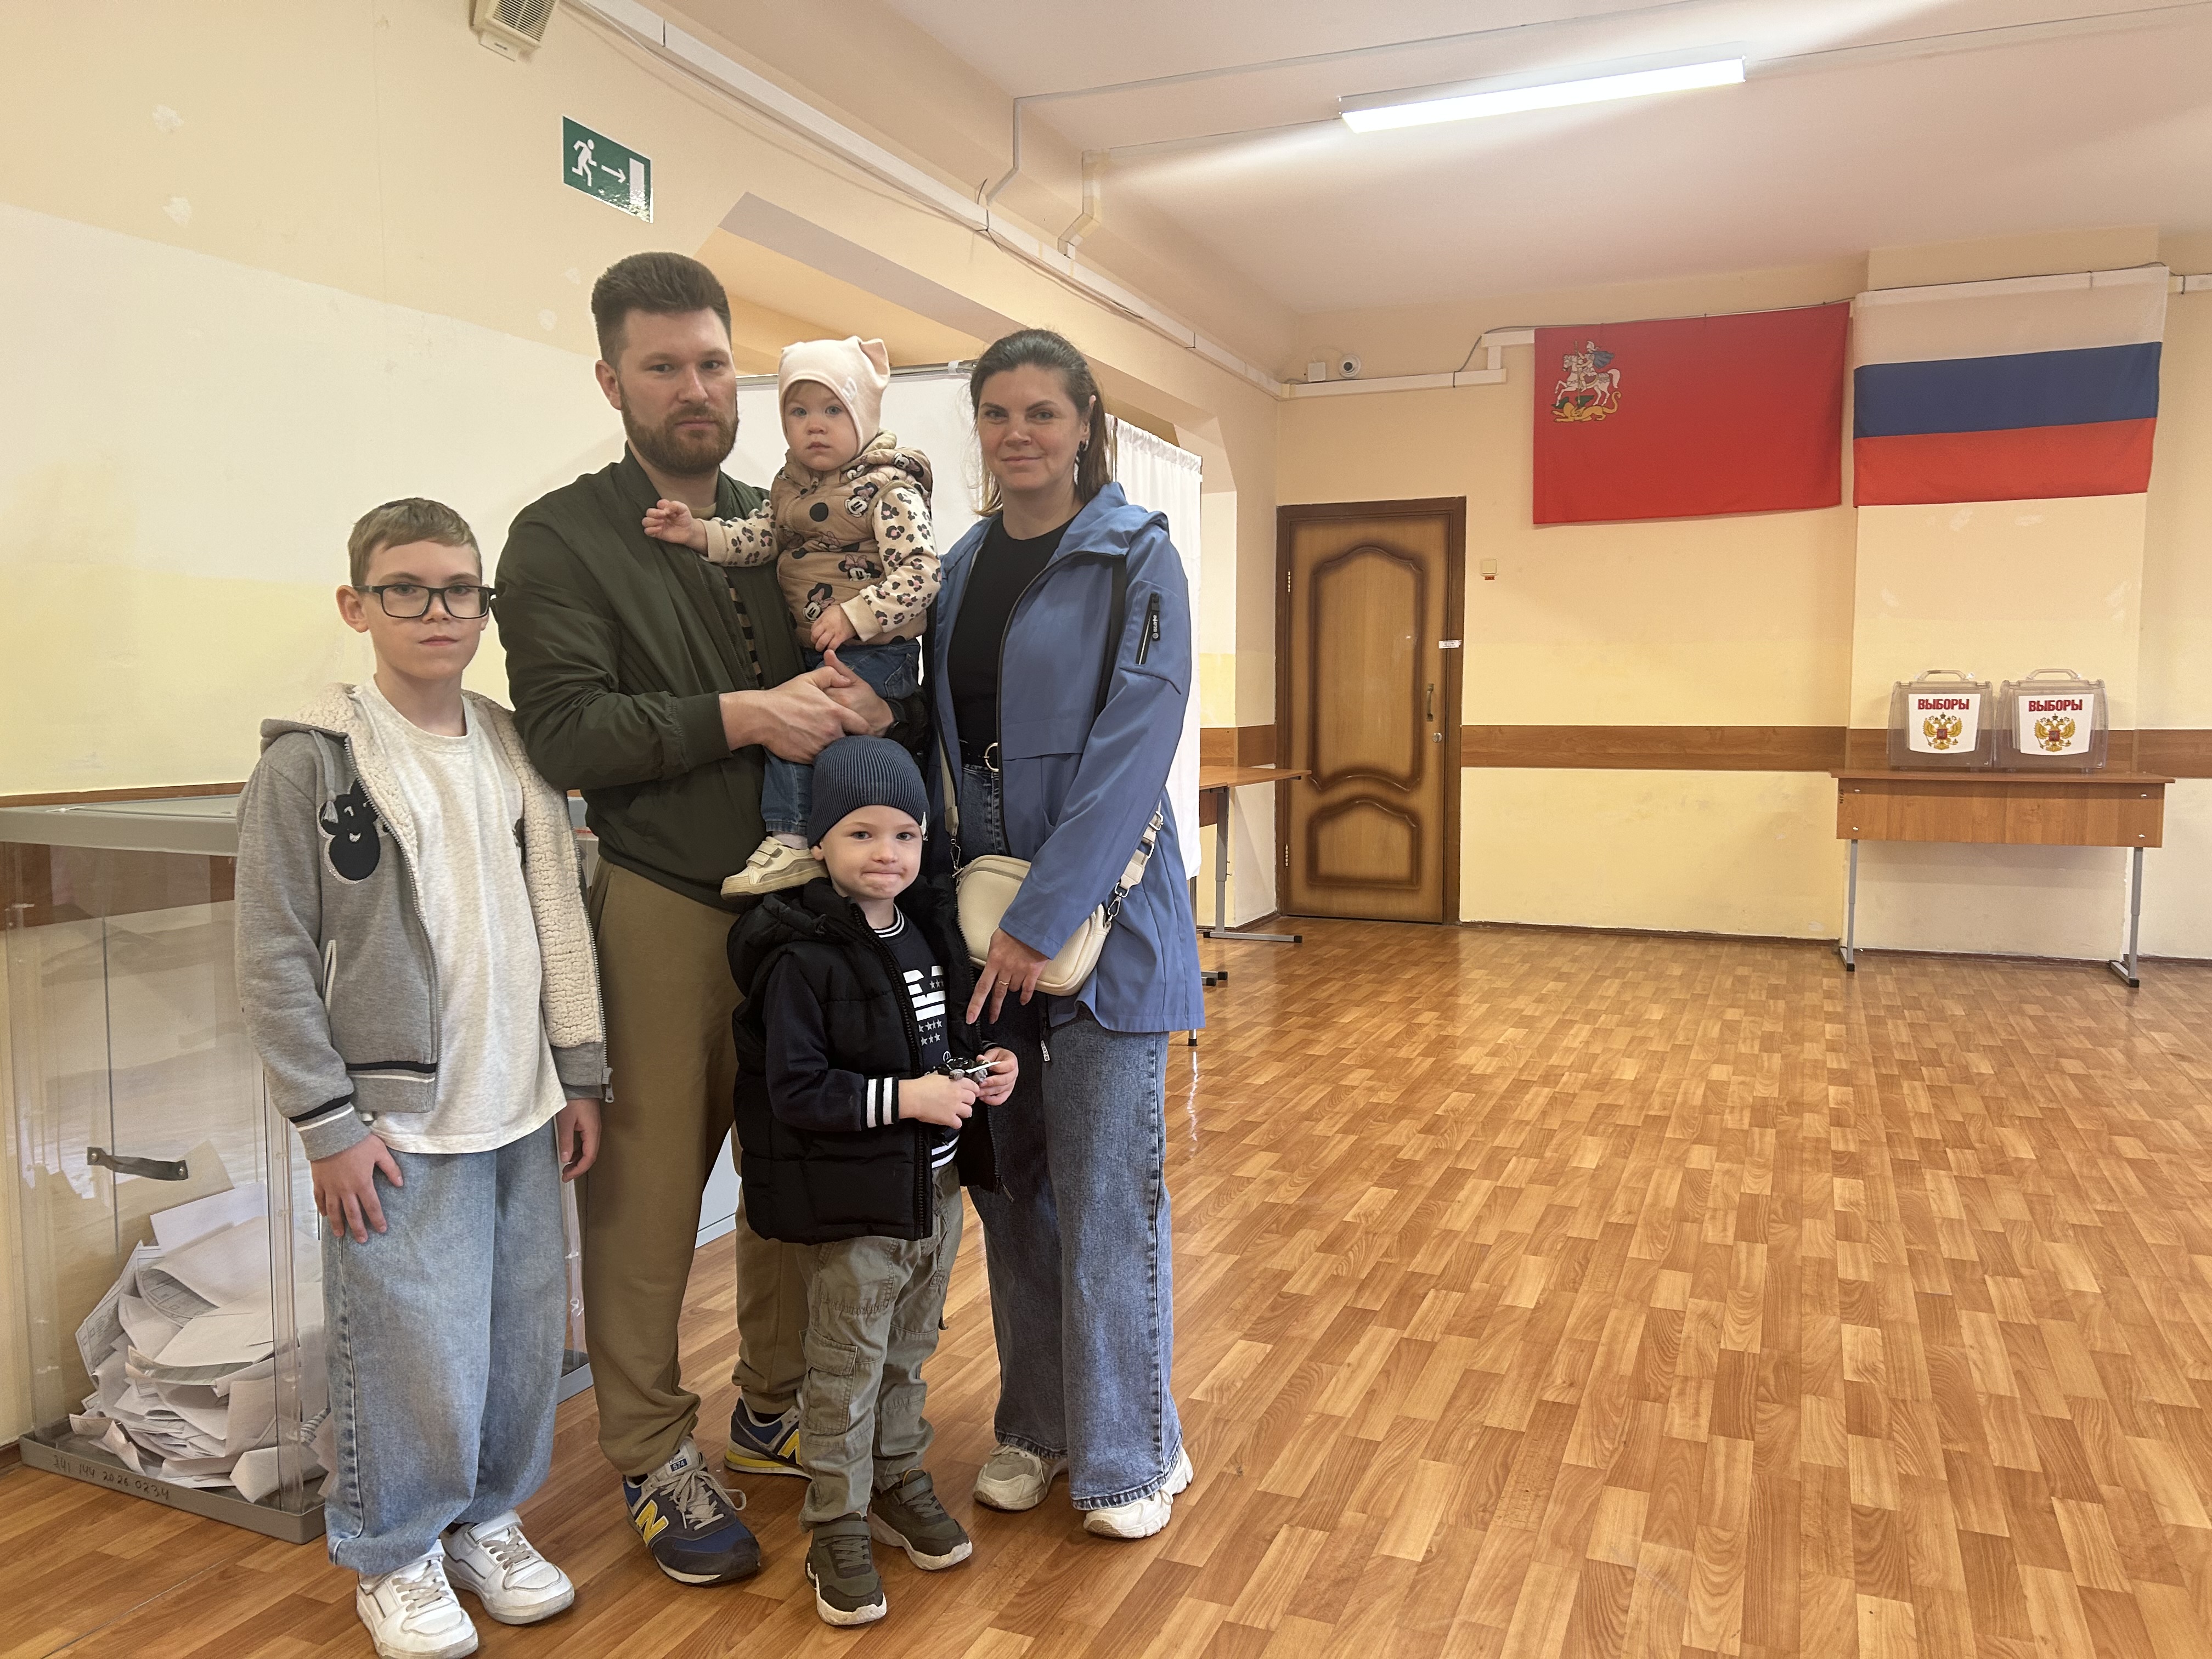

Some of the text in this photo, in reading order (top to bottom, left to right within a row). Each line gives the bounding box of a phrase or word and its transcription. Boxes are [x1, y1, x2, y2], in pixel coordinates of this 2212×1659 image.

[1918, 698, 1970, 710] ВЫБОРЫ
[2029, 699, 2083, 712] ВЫБОРЫ
[673, 1460, 685, 1470] 574
